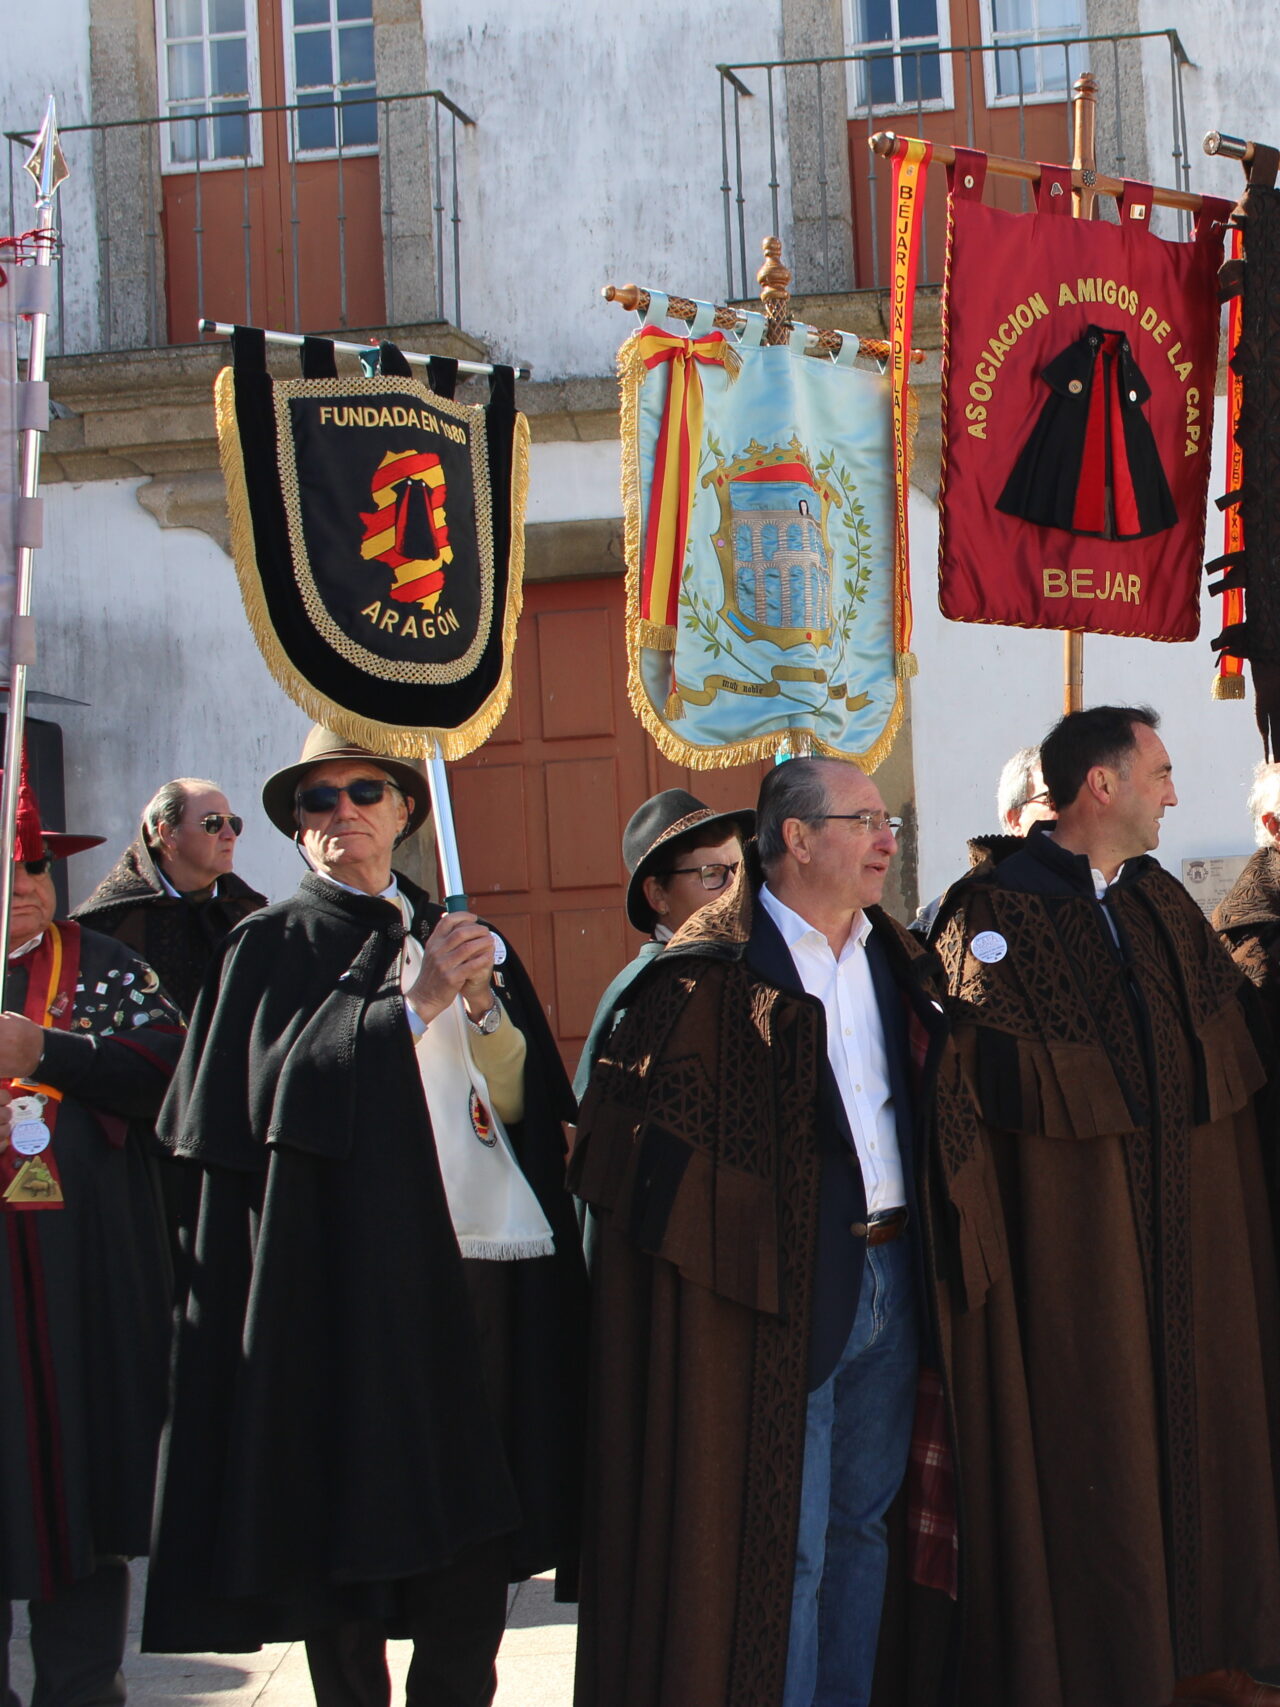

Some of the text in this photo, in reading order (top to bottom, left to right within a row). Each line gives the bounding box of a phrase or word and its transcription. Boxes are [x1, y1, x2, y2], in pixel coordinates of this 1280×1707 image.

[895, 275, 906, 332] CUNA
[894, 340, 903, 370] DE
[965, 277, 1201, 457] ASOCIACION AMIGOS DE LA CAPA
[894, 381, 901, 409] LA
[320, 405, 467, 446] FUNDADA EN 1980
[895, 419, 904, 474] CAPA
[1042, 567, 1141, 606] BEJAR
[360, 600, 461, 640] ARAGÓN
